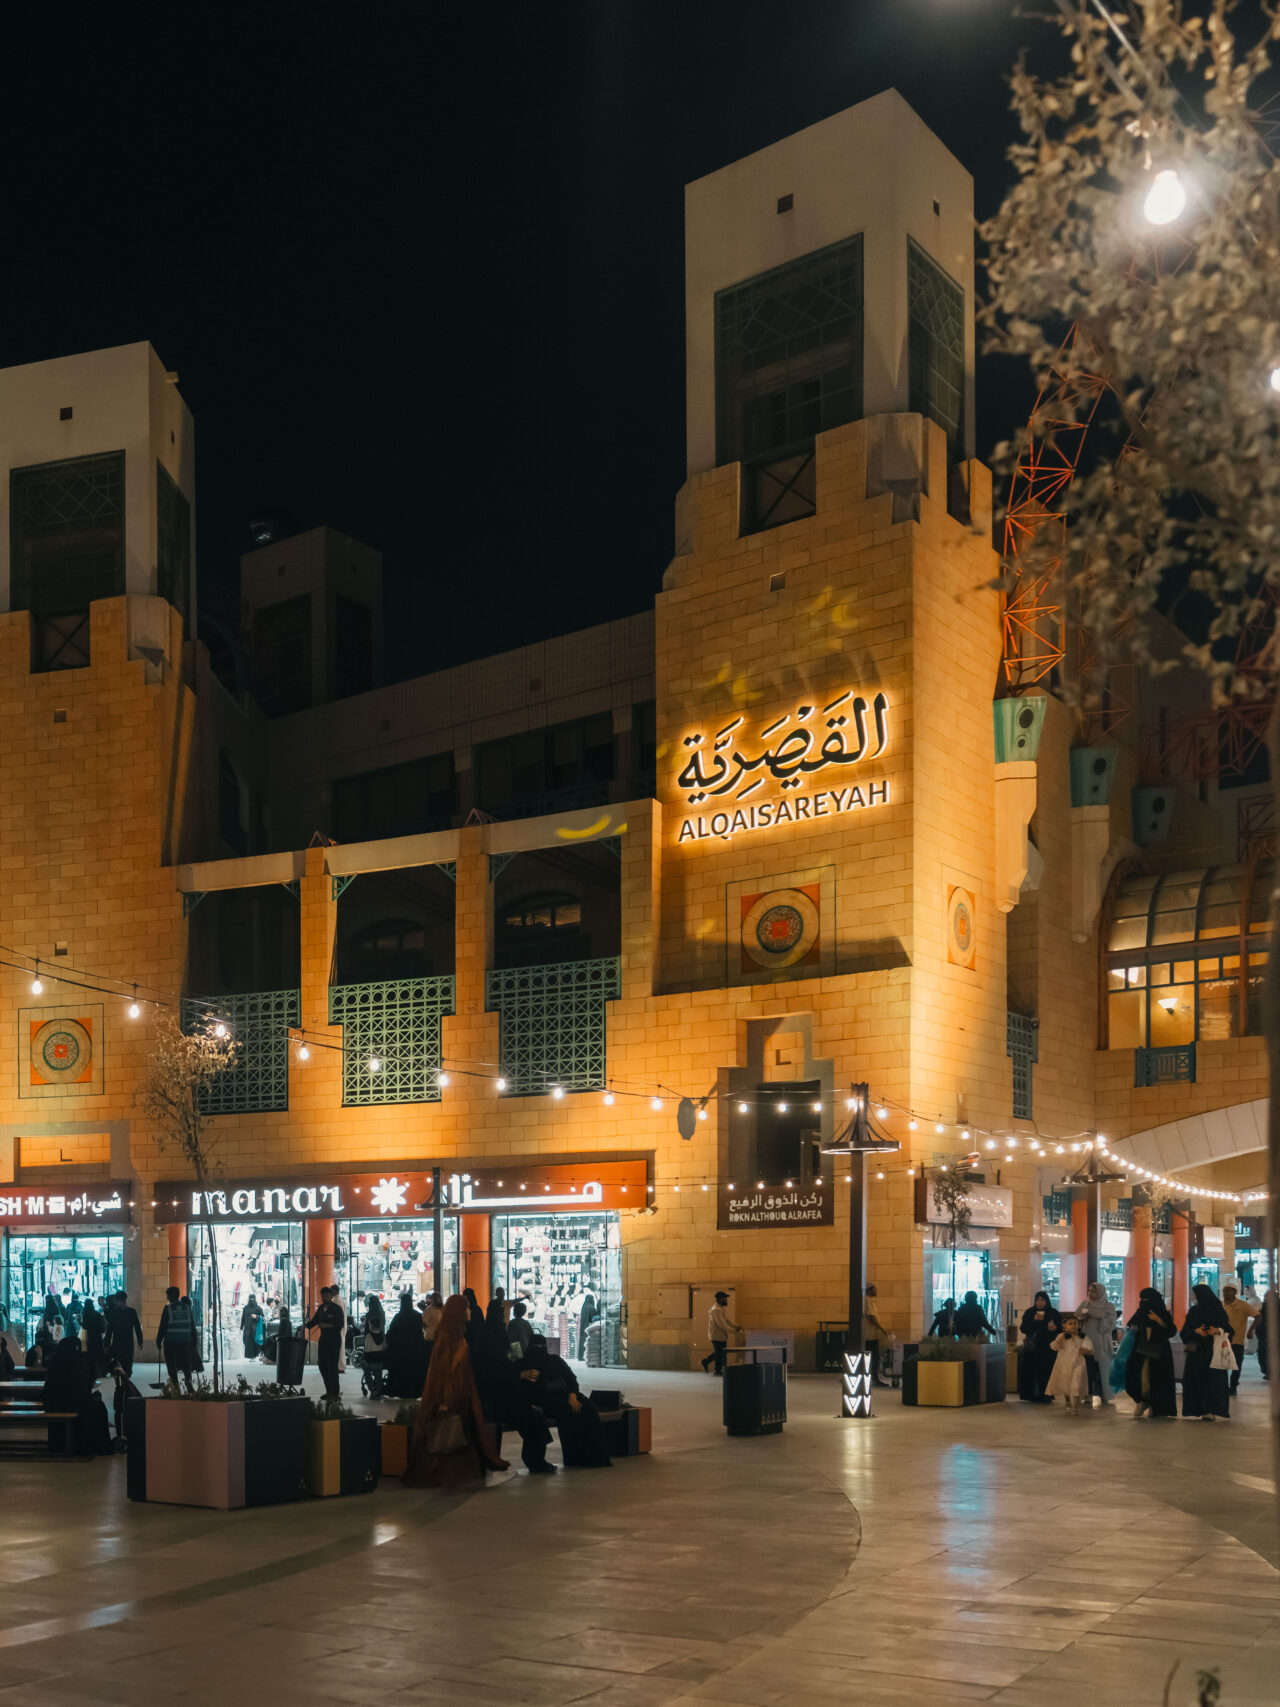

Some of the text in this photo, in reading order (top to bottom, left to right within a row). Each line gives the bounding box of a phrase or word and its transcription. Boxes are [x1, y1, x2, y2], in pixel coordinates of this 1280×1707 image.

[678, 780, 890, 842] ALQAISAREYAH
[192, 1185, 344, 1215] manar
[729, 1192, 823, 1212] ركن الذوق الرفيع
[729, 1210, 822, 1223] ROKN ALTHOUQ ALRAFEA
